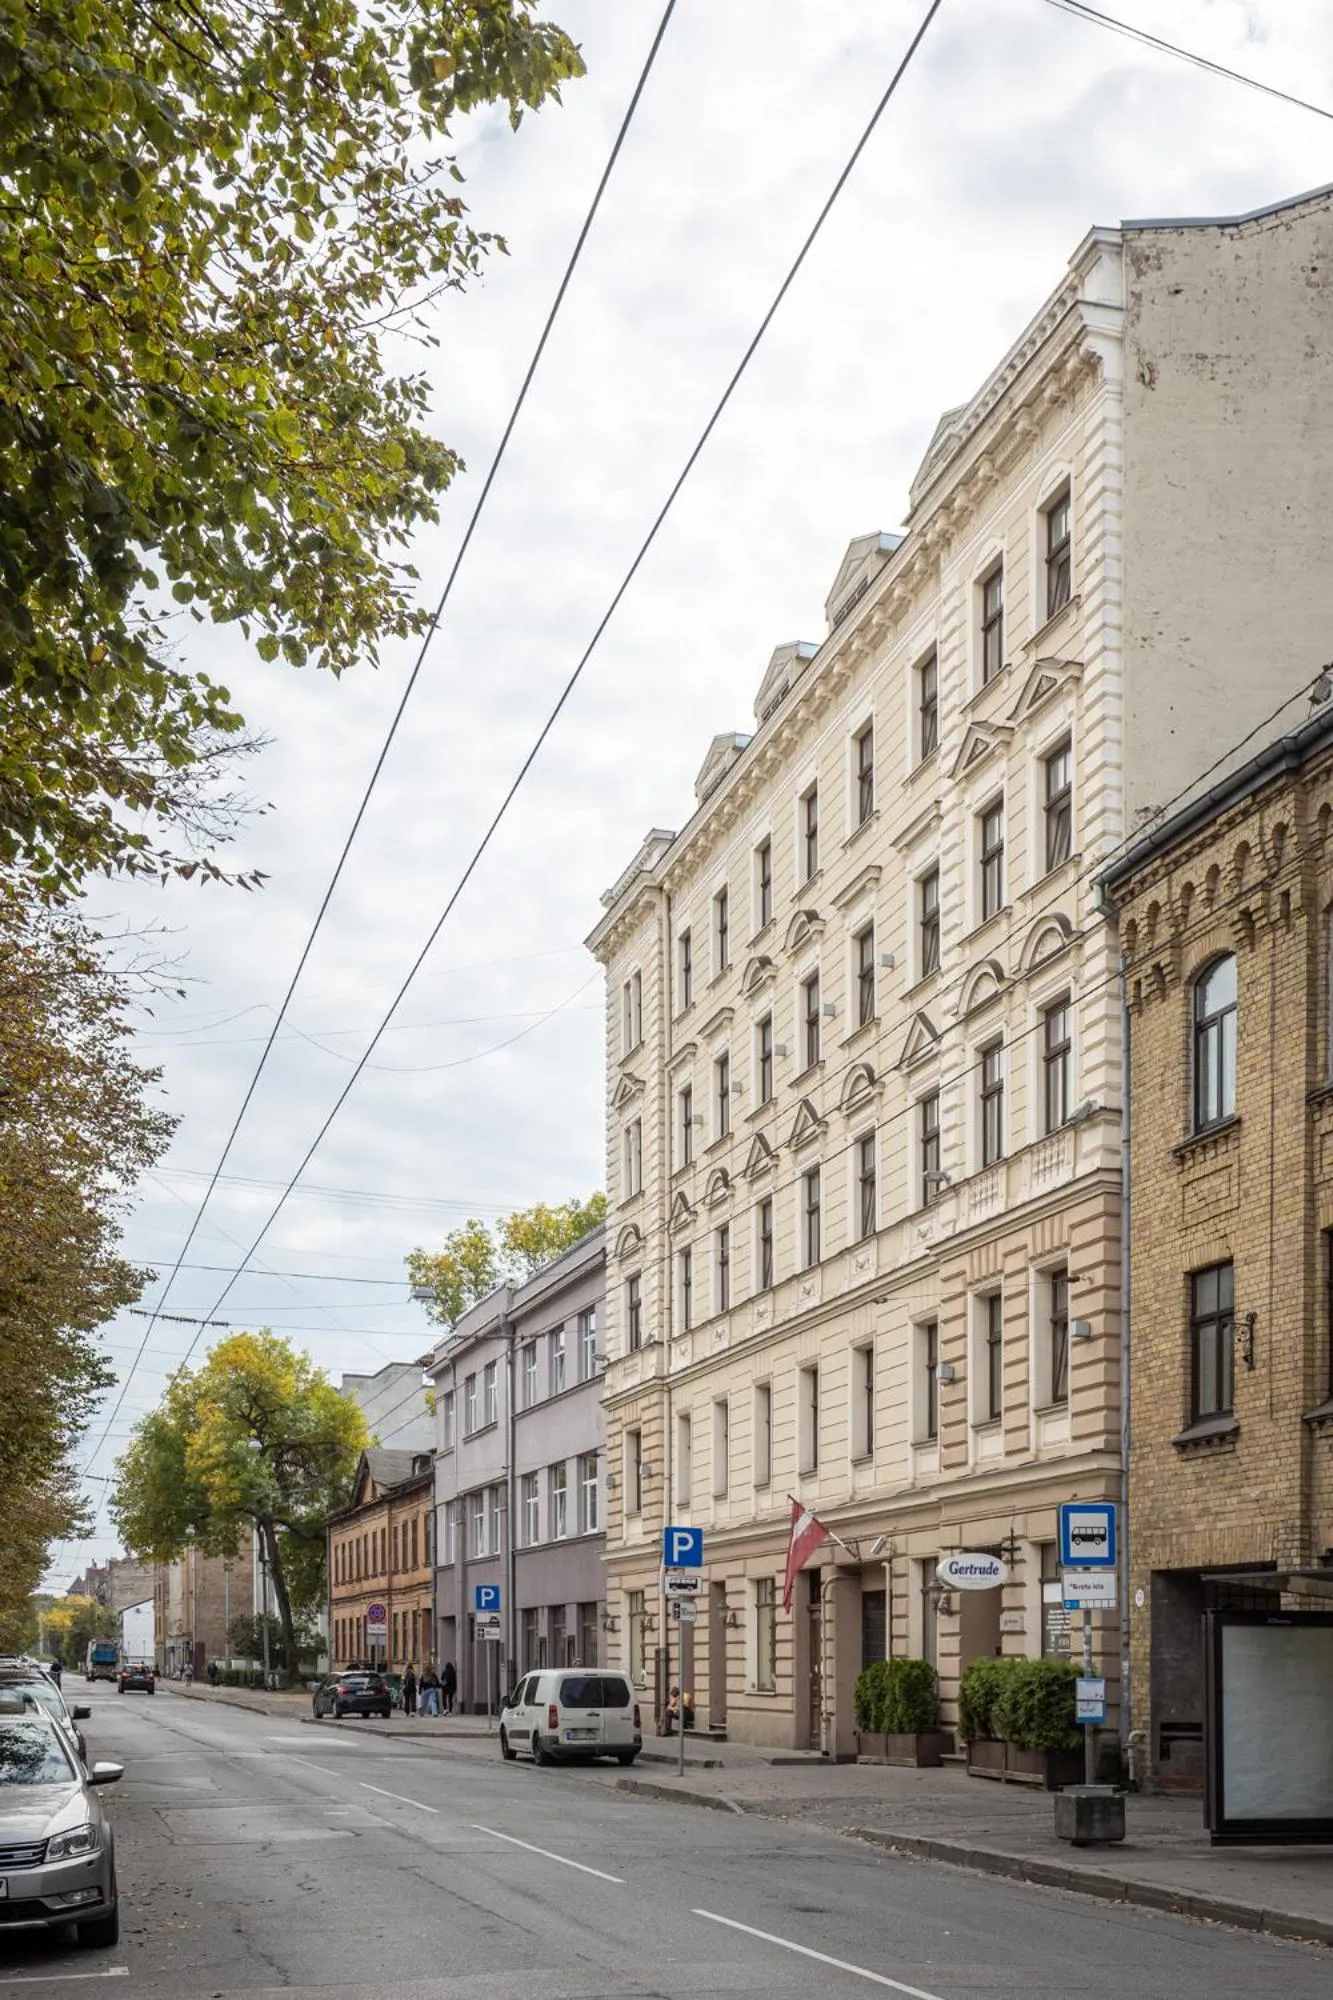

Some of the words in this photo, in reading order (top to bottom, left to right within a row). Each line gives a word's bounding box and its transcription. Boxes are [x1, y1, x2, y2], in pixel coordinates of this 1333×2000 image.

[673, 1532, 694, 1562] P
[949, 1560, 1000, 1576] Gertrude
[481, 1588, 495, 1608] P
